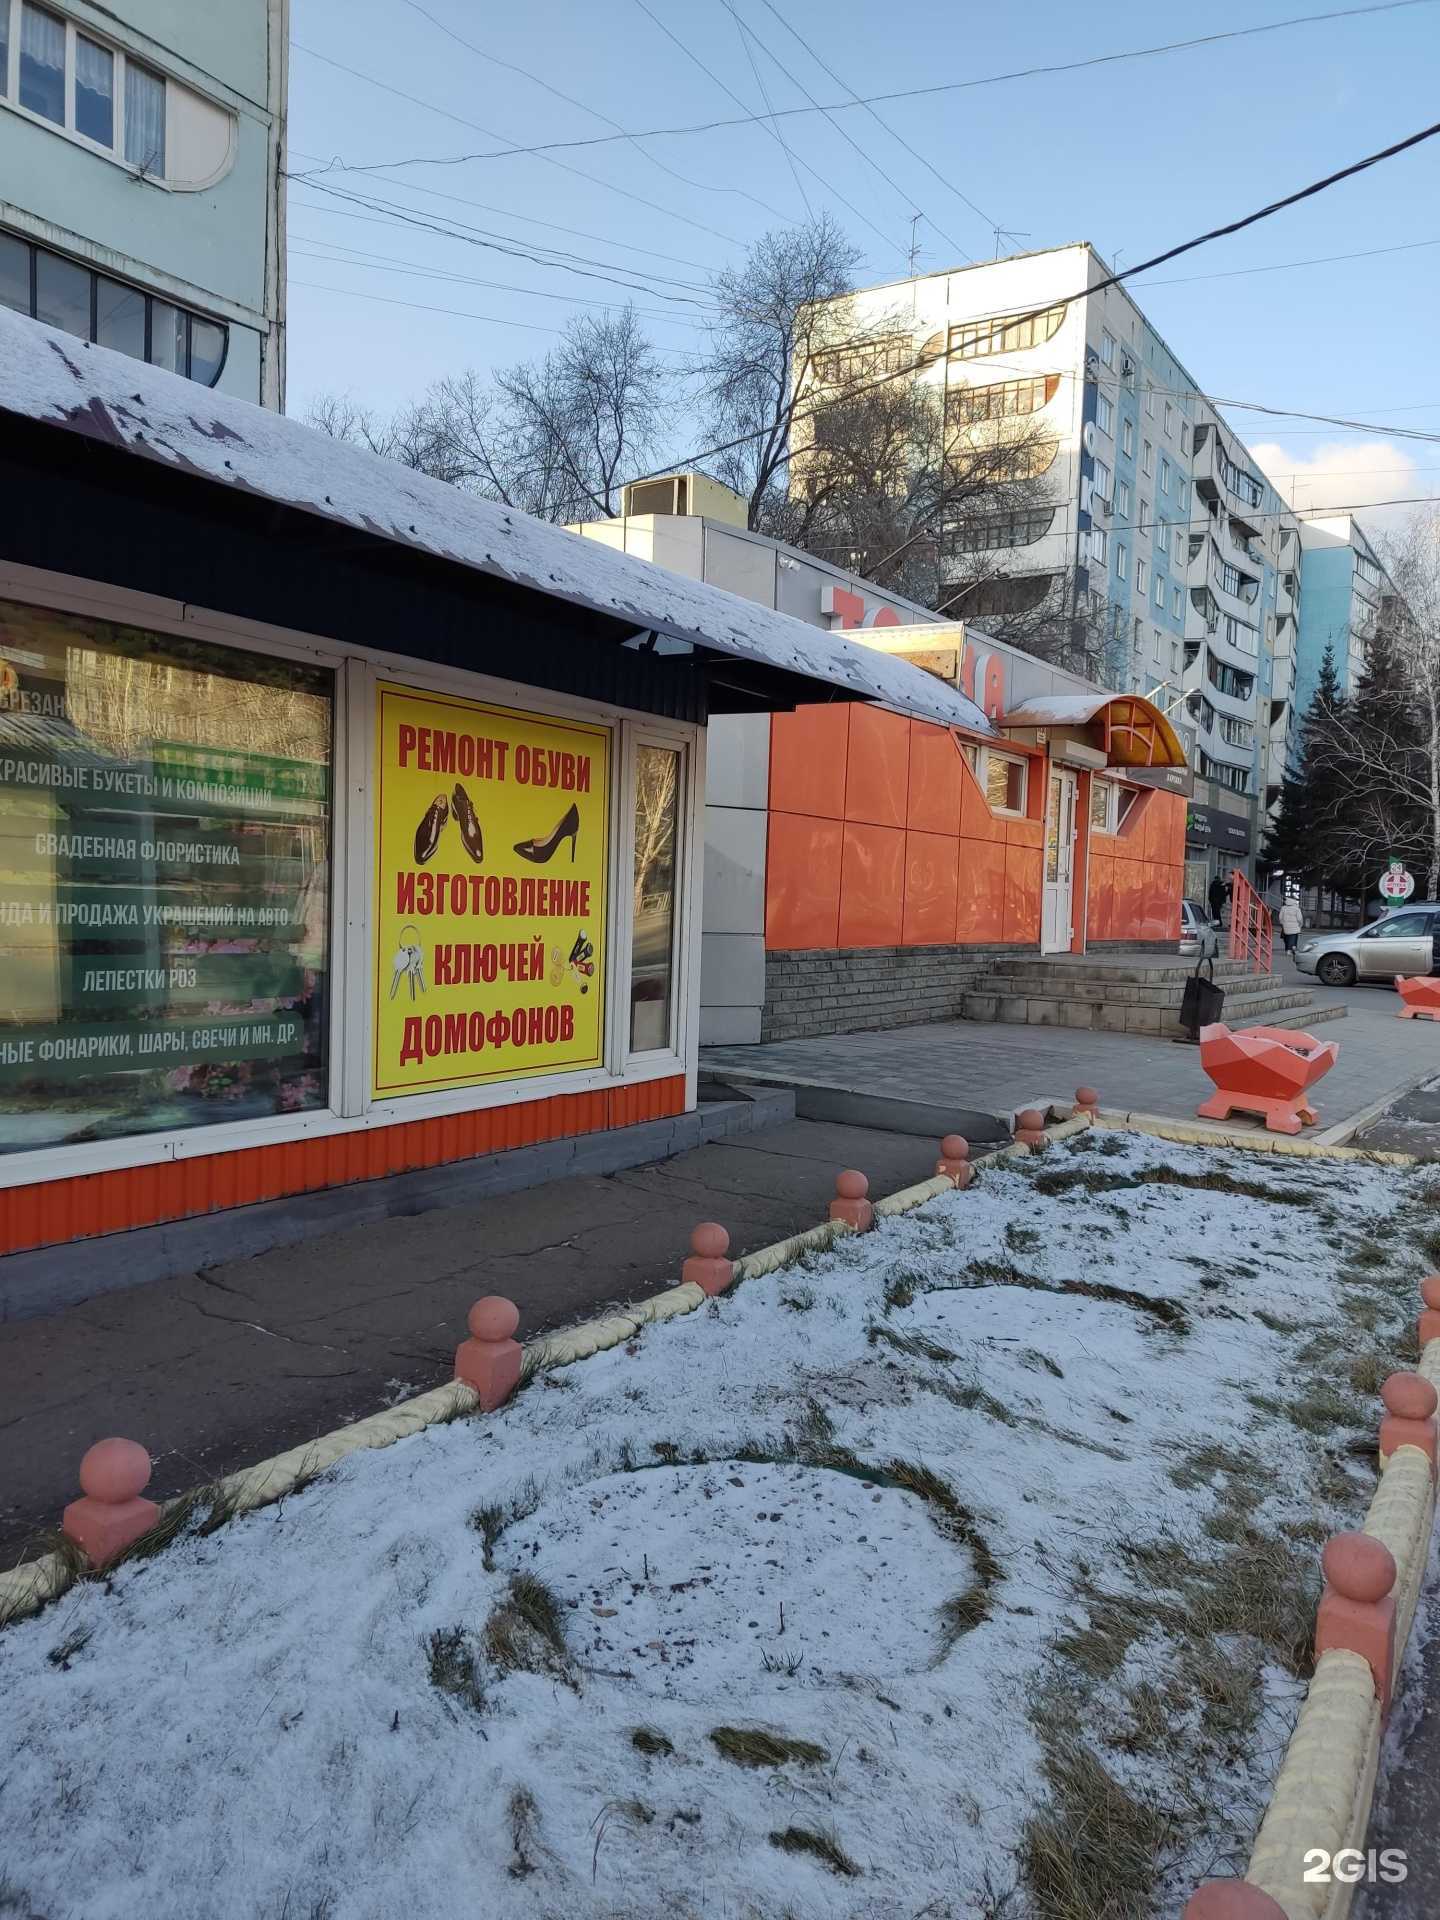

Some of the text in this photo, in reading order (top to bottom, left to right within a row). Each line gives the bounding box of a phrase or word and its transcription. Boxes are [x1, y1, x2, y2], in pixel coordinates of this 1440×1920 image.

[398, 724, 591, 793] РЕМОНТ ОБУВИ
[93, 769, 157, 797] БУКЕТЫ
[163, 779, 173, 798] И
[177, 780, 272, 810] КОМПОЗИЦИИ
[36, 833, 240, 866] СВАДЕБНАЯ ФЛОРИСТИКА
[397, 871, 591, 917] ИЗГОТОВЛЕНИЕ
[40, 903, 50, 924] И
[56, 903, 138, 927] ПРОДАЖА
[143, 903, 234, 927] УКРАШЕНИЙ
[238, 909, 255, 926] НА
[258, 908, 289, 926] АВТО
[82, 968, 197, 992] ЛЕПЕСТКИ РОЗ
[434, 935, 544, 985] КЛЮЧЕЙ
[38, 1034, 134, 1061] ФОНАРИКИ,
[138, 1030, 188, 1054] ШАРЫ,
[192, 1028, 238, 1049] СВЕЧИ
[239, 1028, 249, 1046] И
[252, 1027, 274, 1045] МН.
[277, 1023, 298, 1045] ДР.
[399, 1004, 574, 1066] ДОМОФОНОВ
